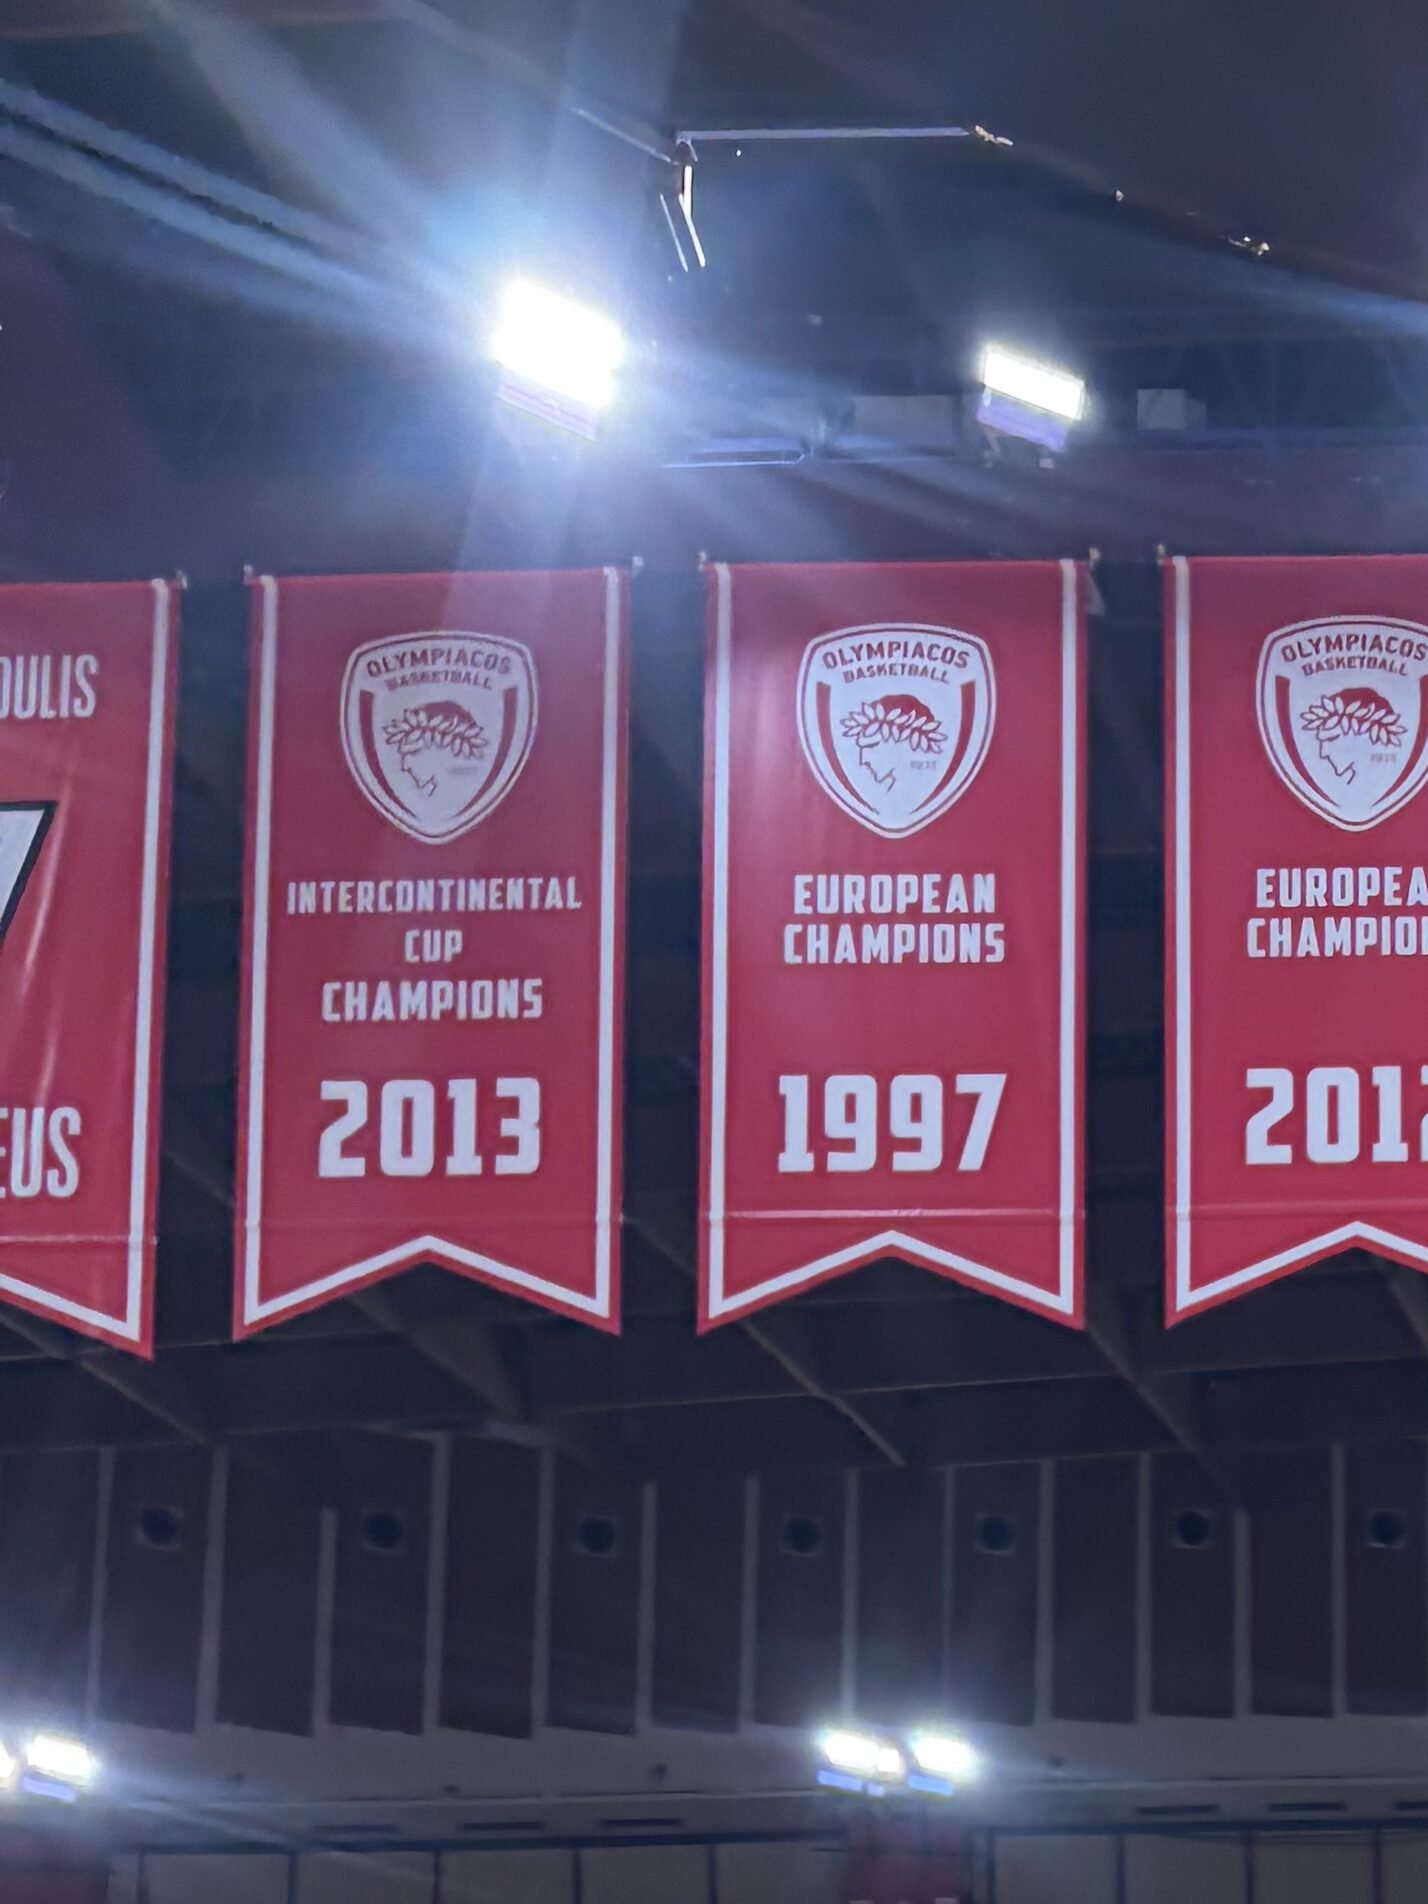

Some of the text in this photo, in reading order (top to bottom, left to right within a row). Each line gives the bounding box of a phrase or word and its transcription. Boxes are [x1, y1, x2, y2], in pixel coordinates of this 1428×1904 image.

[367, 649, 511, 677] OLYMPIACOS
[822, 641, 970, 669] OLYMPIACOS
[1281, 633, 1428, 663] OLYMPIACOS
[287, 877, 582, 914] INTERCONTINENTAL
[794, 873, 995, 914] EUROPEAN
[405, 930, 462, 963] CUP
[784, 923, 1005, 964] CHAMPIONS
[322, 978, 542, 1021] CHAMPIONS
[318, 1077, 540, 1177] 2013
[778, 1073, 1007, 1172] 1997
[0, 1106, 82, 1198] US
